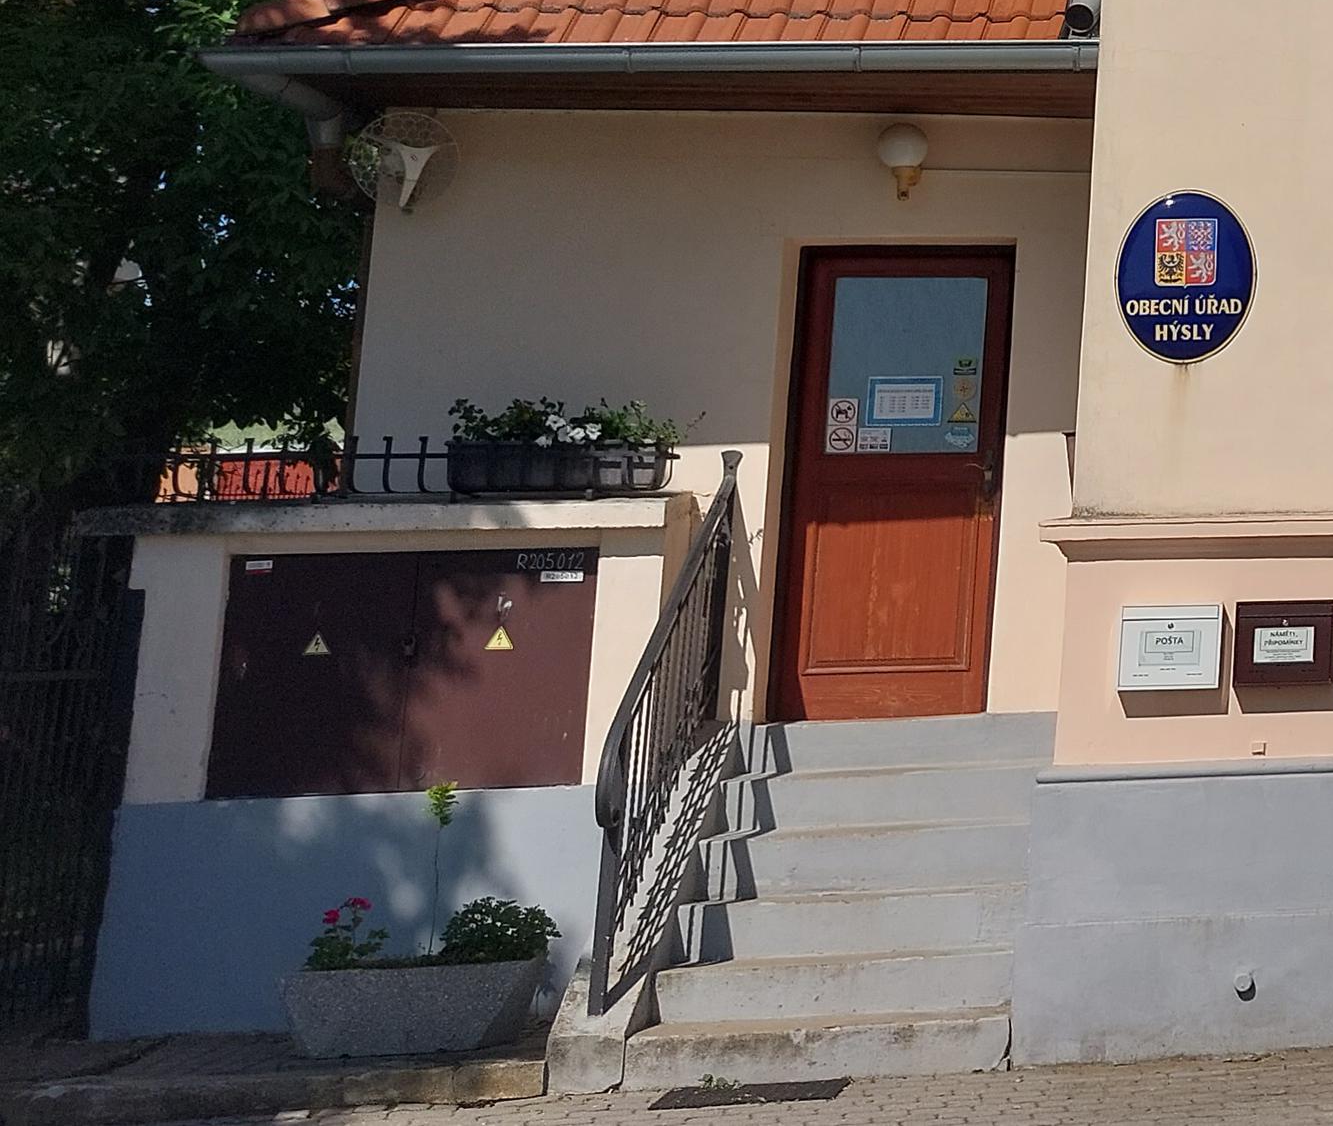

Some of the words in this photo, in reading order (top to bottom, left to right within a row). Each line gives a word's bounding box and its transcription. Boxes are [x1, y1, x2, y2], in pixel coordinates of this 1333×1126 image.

[1126, 295, 1189, 316] OBECNÍ
[1194, 294, 1242, 315] ÚŘAD
[1155, 320, 1214, 341] HÝSLY
[1155, 634, 1184, 646] POŠTA
